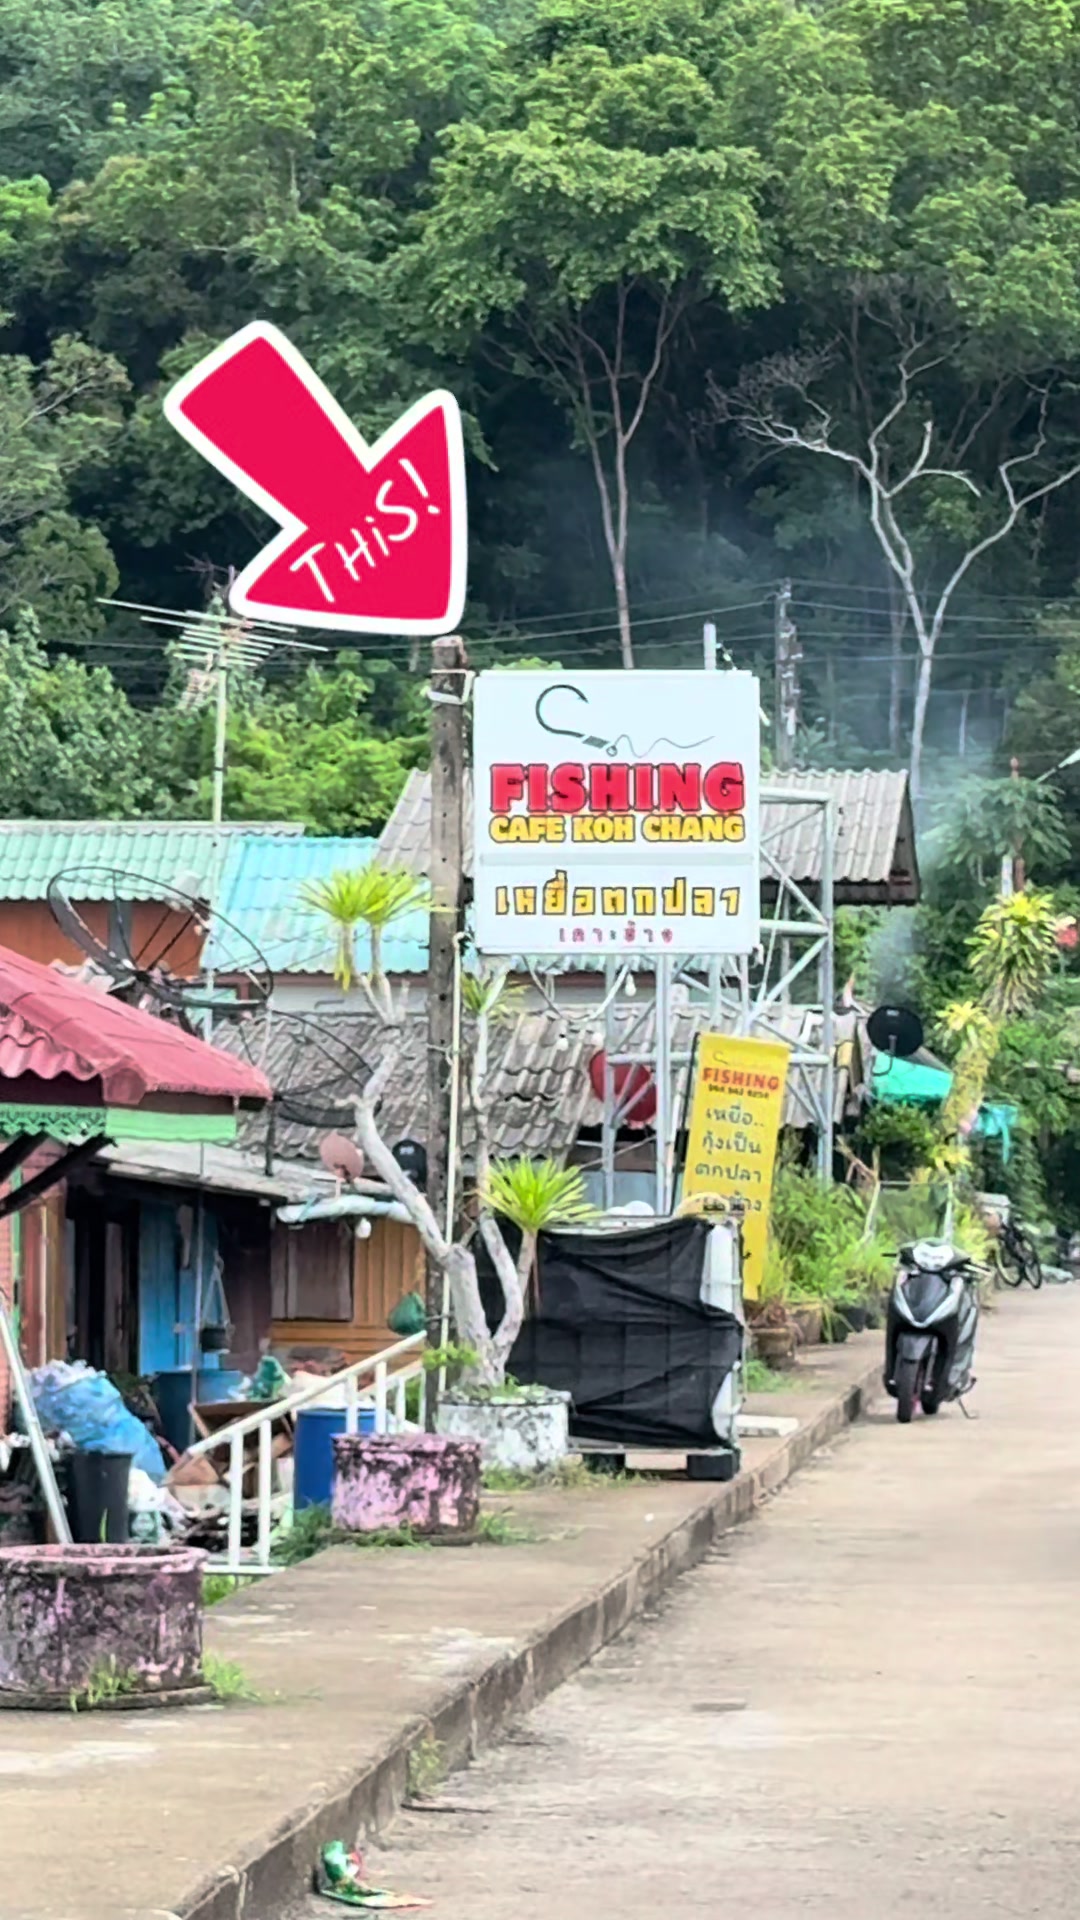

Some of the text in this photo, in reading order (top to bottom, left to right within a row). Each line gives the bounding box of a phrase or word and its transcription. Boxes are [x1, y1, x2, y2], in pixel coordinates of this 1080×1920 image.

[489, 762, 746, 813] FISHING
[488, 814, 746, 843] CAFE KOH CHANG
[495, 869, 741, 917] เหยื่อตกปลา
[694, 1163, 762, 1184] ตกปลา
